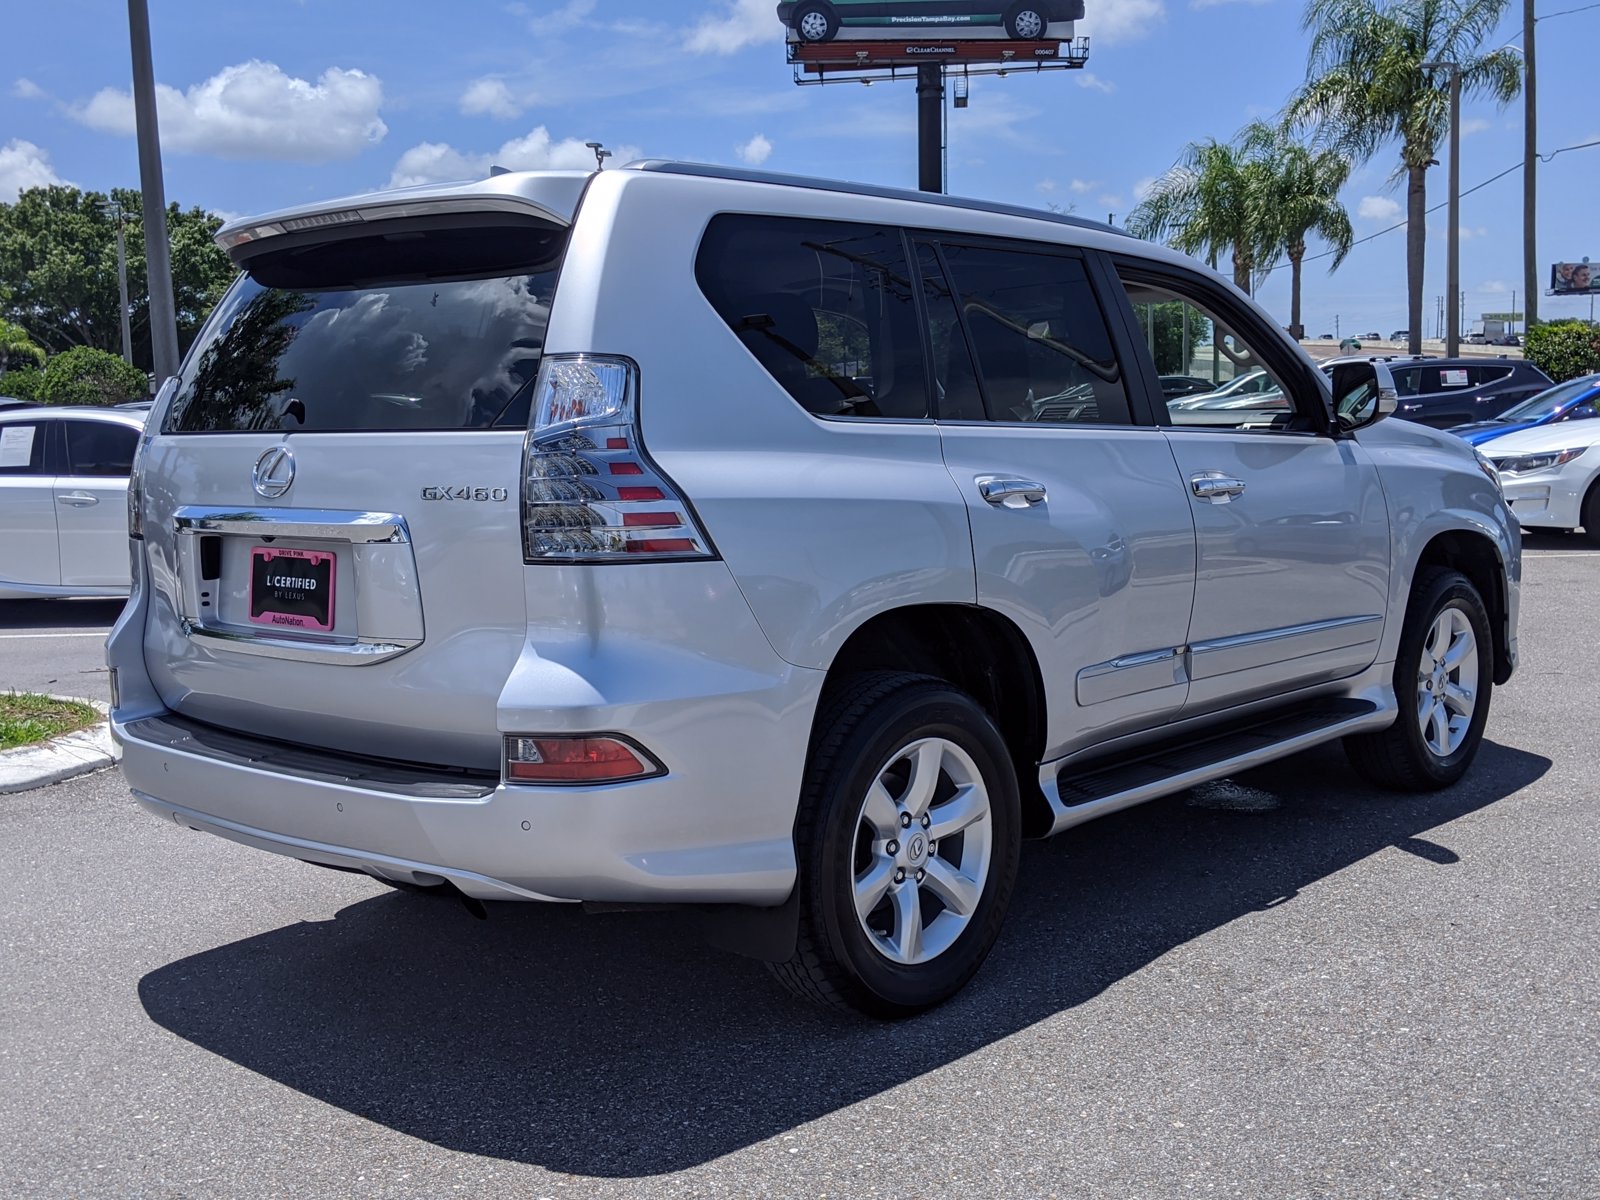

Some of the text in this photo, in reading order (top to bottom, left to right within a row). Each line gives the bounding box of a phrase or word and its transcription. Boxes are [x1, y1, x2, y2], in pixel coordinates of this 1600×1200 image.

[274, 590, 305, 600] BY LEXUS
[271, 614, 304, 627] AutoNation
